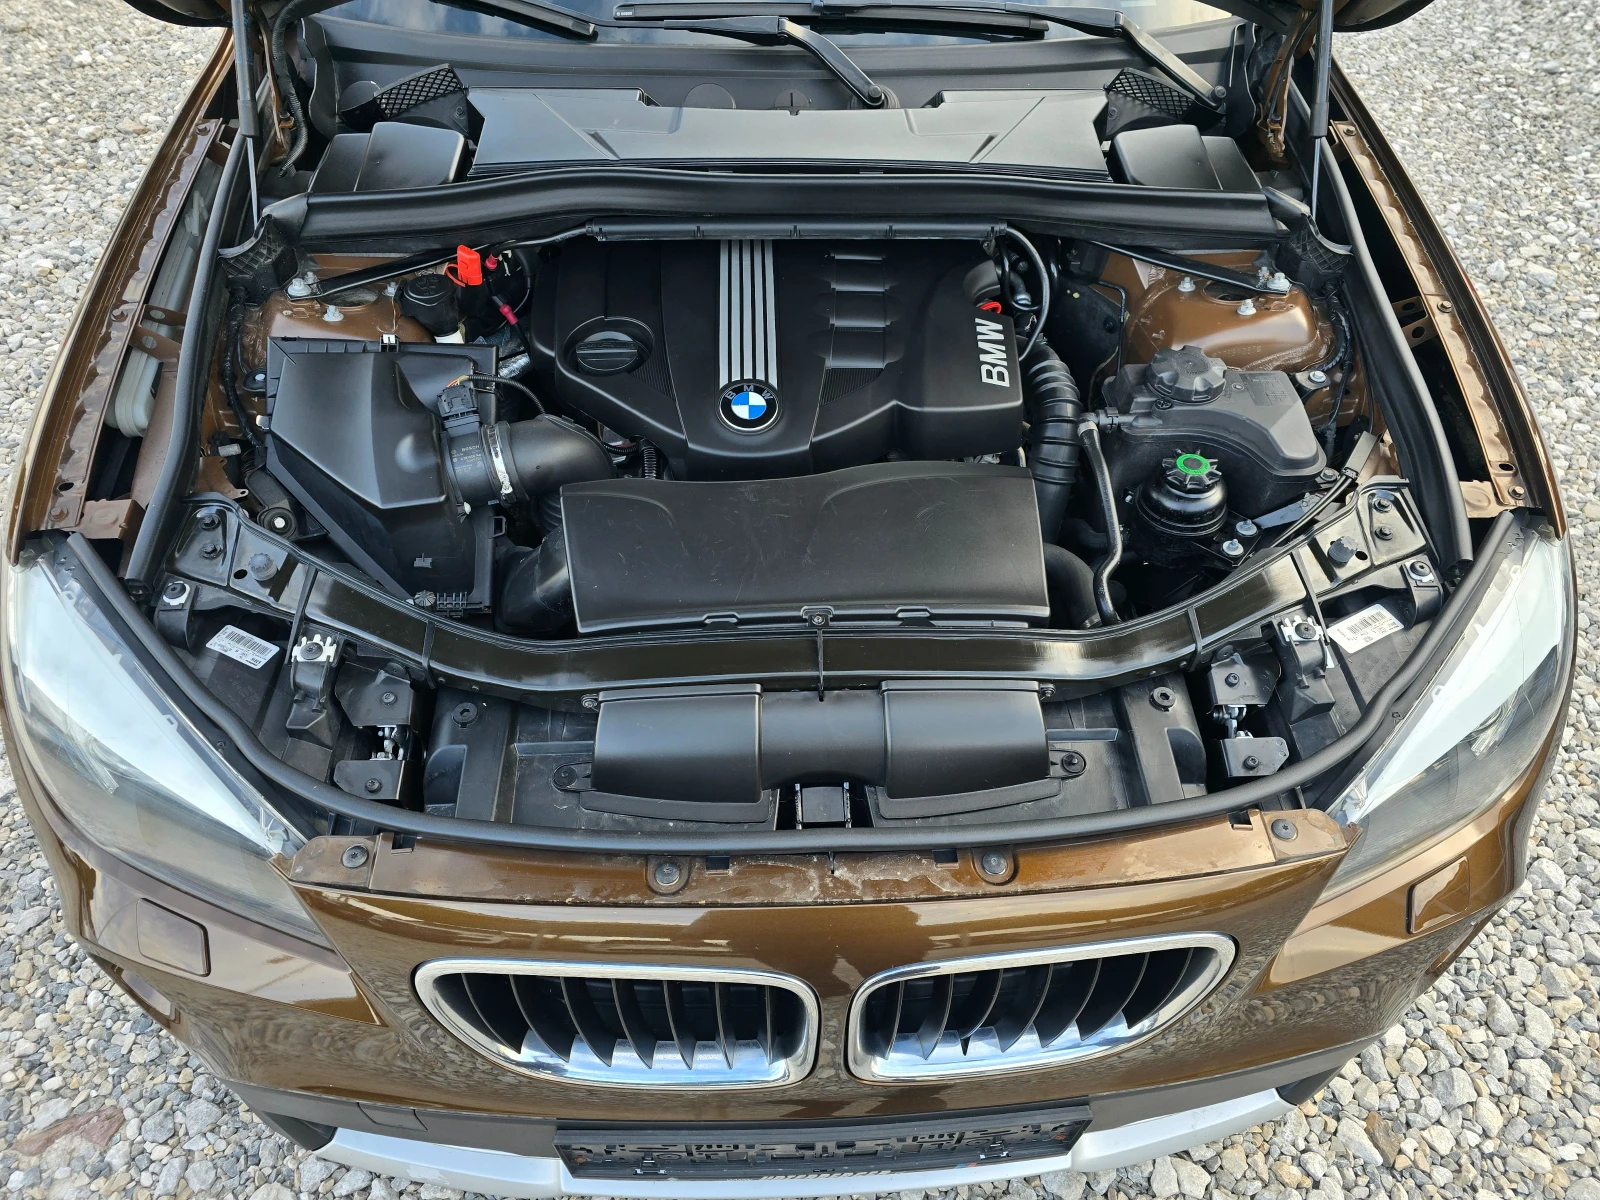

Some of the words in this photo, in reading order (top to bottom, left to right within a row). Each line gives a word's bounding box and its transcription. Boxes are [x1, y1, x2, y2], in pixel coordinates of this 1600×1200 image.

[974, 317, 1010, 388] BMW
[724, 384, 774, 400] BMW
[461, 444, 480, 452] BOSCH
